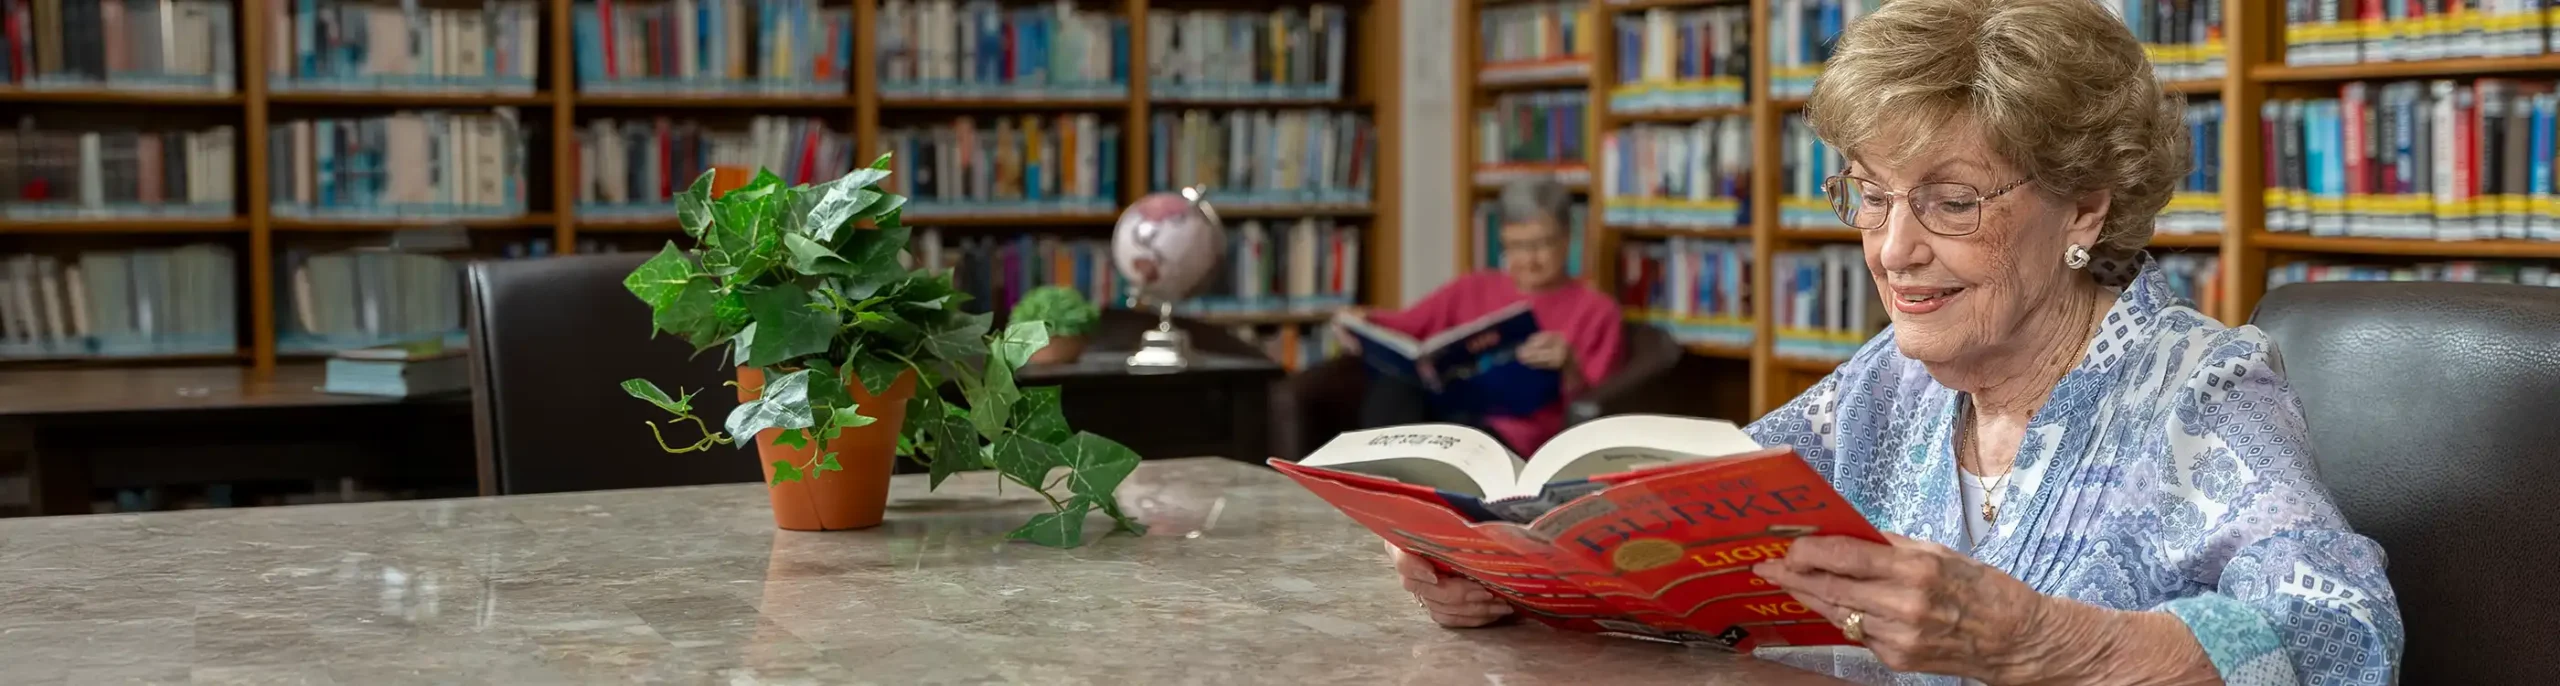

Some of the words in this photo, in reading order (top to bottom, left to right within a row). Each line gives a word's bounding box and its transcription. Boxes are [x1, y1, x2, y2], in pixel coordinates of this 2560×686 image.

[1575, 485, 1827, 554] BURKE
[1691, 541, 1791, 567] LIGH
[1749, 578, 1765, 586] O
[1744, 601, 1810, 616] WO
